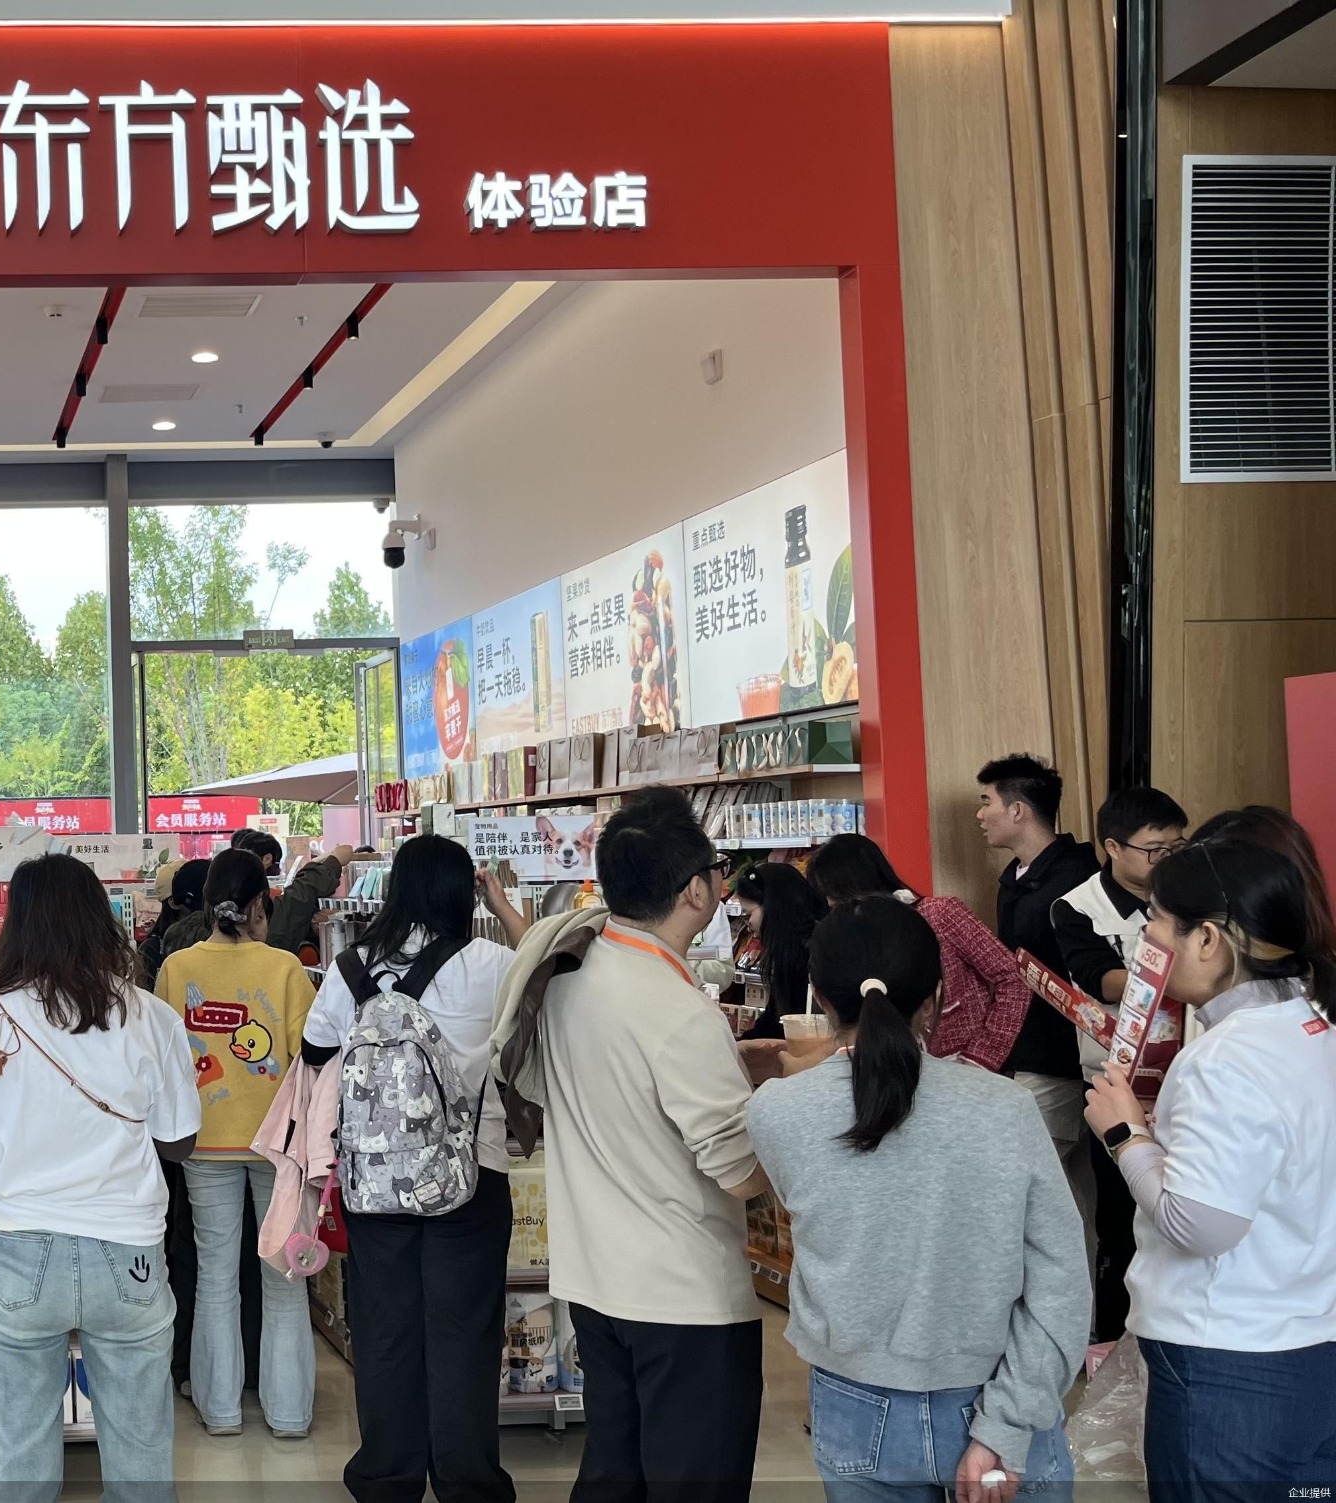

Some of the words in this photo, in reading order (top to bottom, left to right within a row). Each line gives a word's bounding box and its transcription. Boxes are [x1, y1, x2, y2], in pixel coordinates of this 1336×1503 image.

[466, 171, 647, 231] 体验店
[692, 520, 725, 551] 重点甄选
[693, 544, 764, 599] 甄选好物，
[566, 577, 591, 601] 坚果炒货
[567, 593, 631, 643] 来一点坚果，
[695, 589, 767, 643] 美好生活。
[477, 637, 515, 673] 早晨一杯，
[568, 636, 621, 679] 营养相伴。
[572, 712, 599, 735] EASTBUY
[24, 815, 80, 831] 员服务站
[155, 812, 227, 828] 会员服务站
[75, 845, 110, 854] 美好生活
[475, 831, 553, 844] 是陪伴，是家人
[475, 844, 559, 856] 值得被认真对待。
[512, 1216, 544, 1227] astBuy
